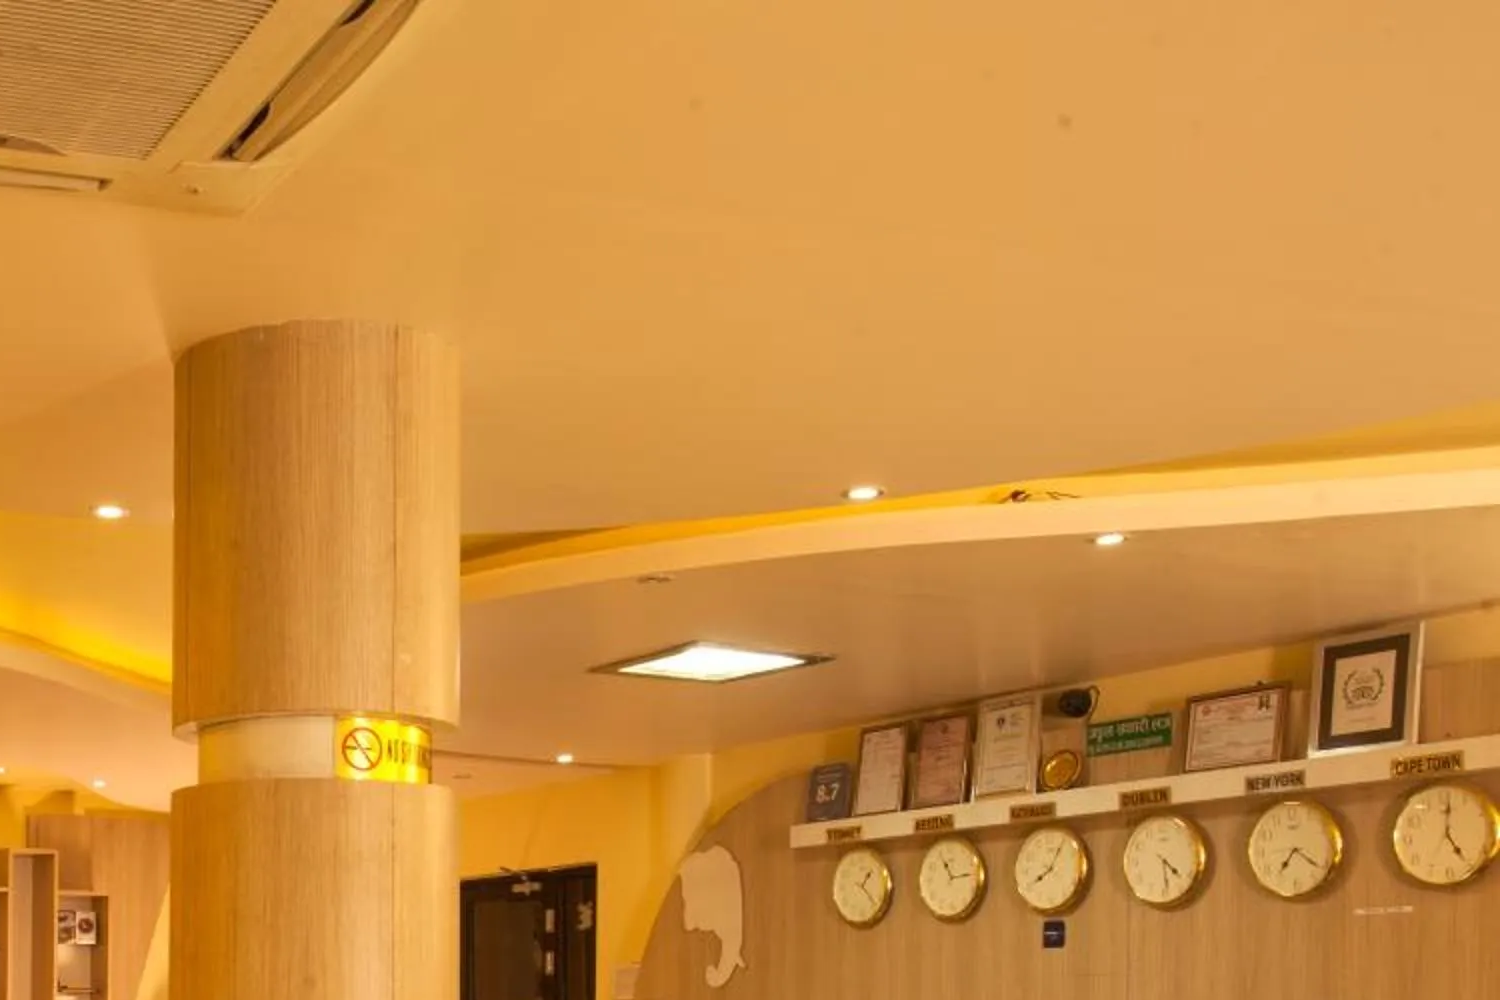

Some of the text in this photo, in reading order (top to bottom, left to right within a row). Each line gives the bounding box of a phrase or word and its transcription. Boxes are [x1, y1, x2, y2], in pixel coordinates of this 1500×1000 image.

[1394, 751, 1462, 776] CAPE TOWN
[1247, 770, 1305, 791] NEW YORK
[1121, 787, 1169, 807] DUBLIN
